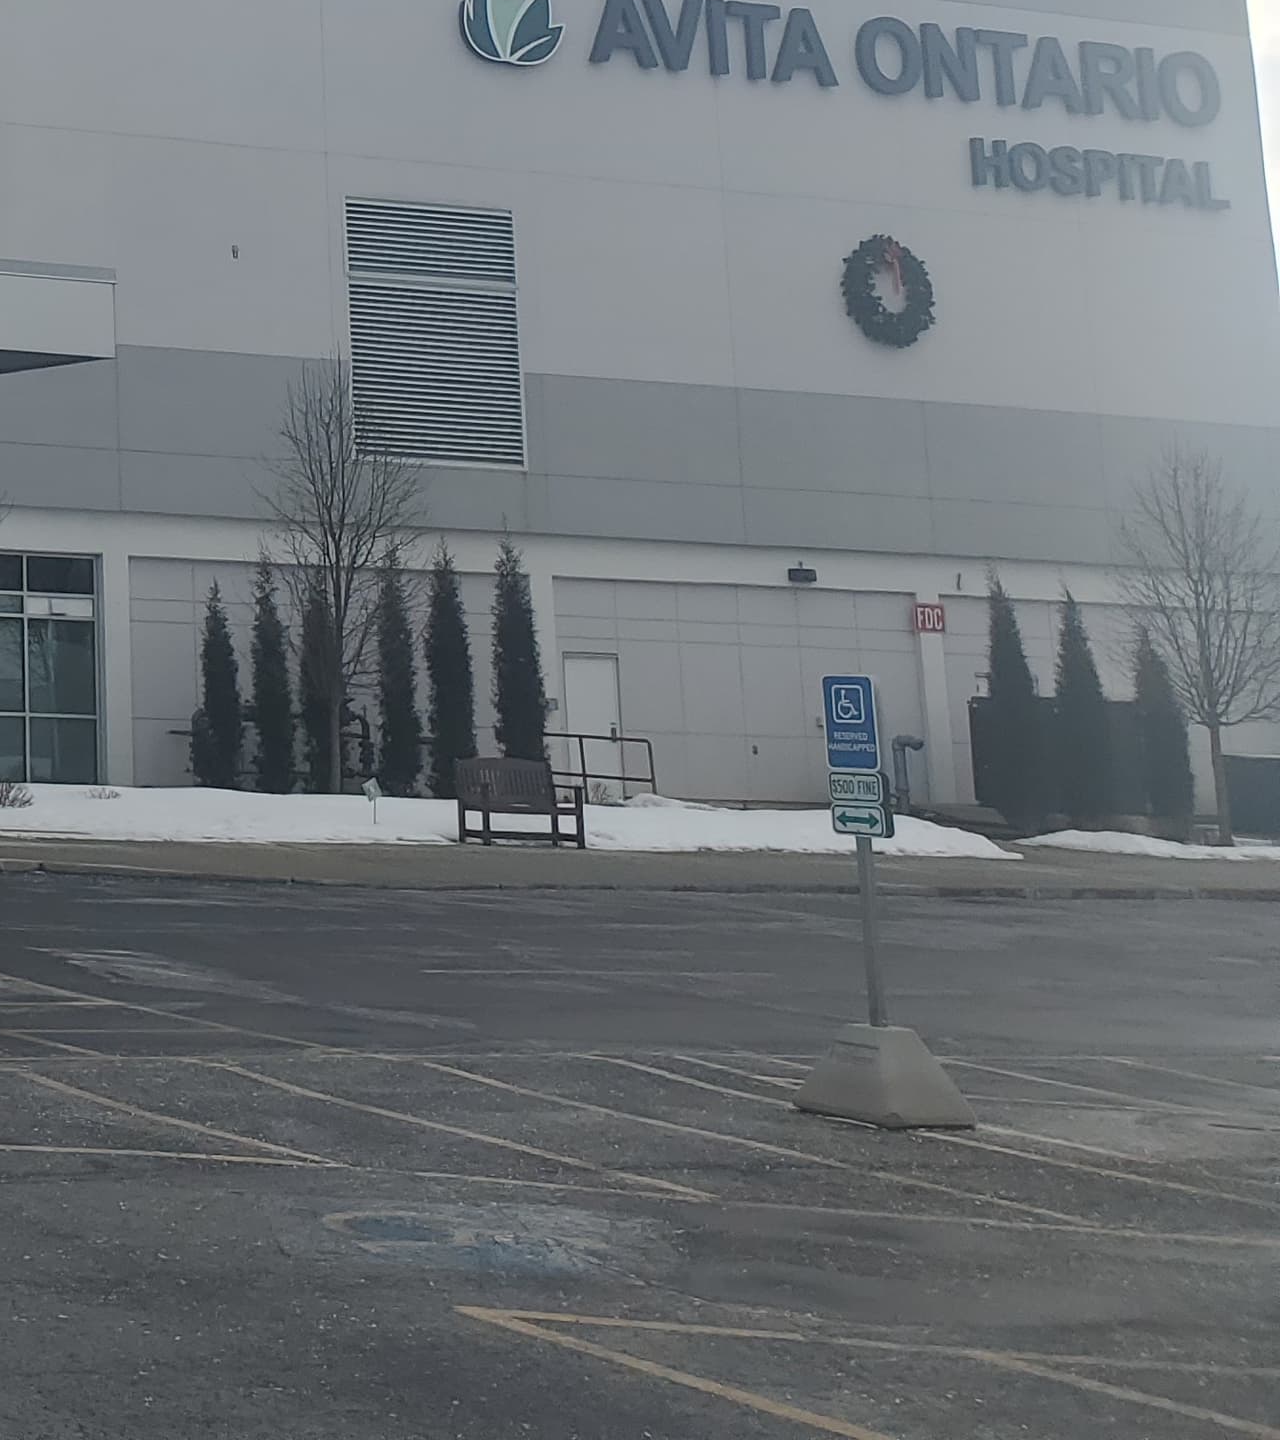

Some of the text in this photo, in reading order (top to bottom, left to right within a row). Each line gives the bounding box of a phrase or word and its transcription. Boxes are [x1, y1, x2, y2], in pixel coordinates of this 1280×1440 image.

[854, 15, 1223, 128] ONTARIO
[968, 136, 1231, 211] HOSPITAL
[916, 607, 943, 630] FDC
[831, 778, 878, 796] $500 FINE
